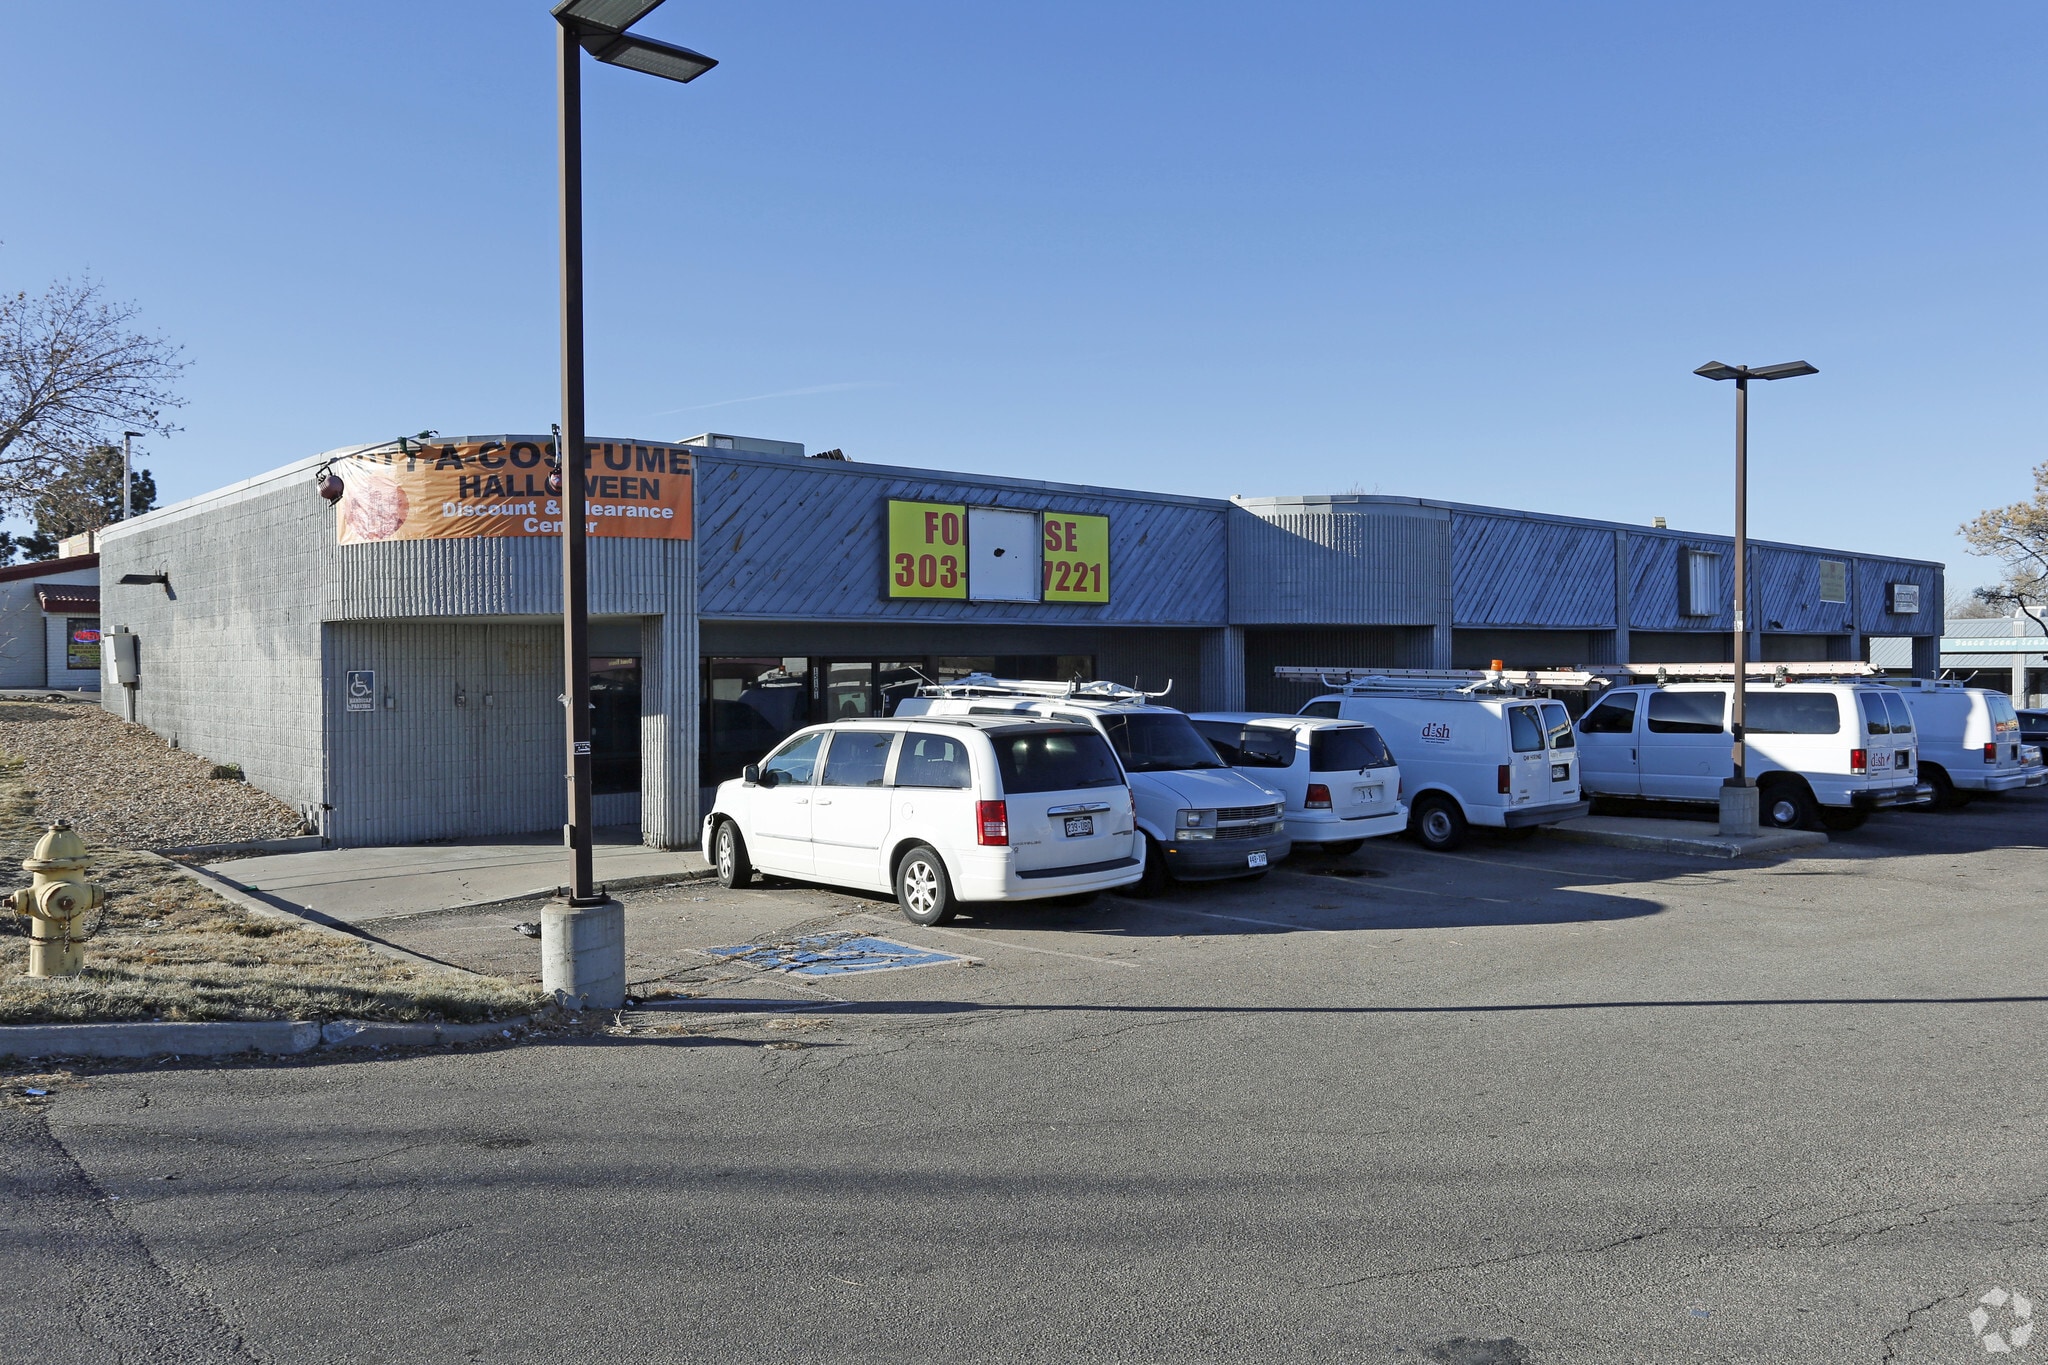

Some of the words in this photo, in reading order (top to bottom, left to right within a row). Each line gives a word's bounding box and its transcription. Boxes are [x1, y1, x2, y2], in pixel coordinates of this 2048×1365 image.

[442, 500, 536, 517] Discount
[544, 499, 561, 515] &
[585, 500, 674, 519] learance
[524, 517, 598, 533] Cenr
[924, 511, 966, 546] FO
[1044, 560, 1101, 593] 7221
[1422, 722, 1450, 738] dish
[1871, 752, 1885, 767] dish
